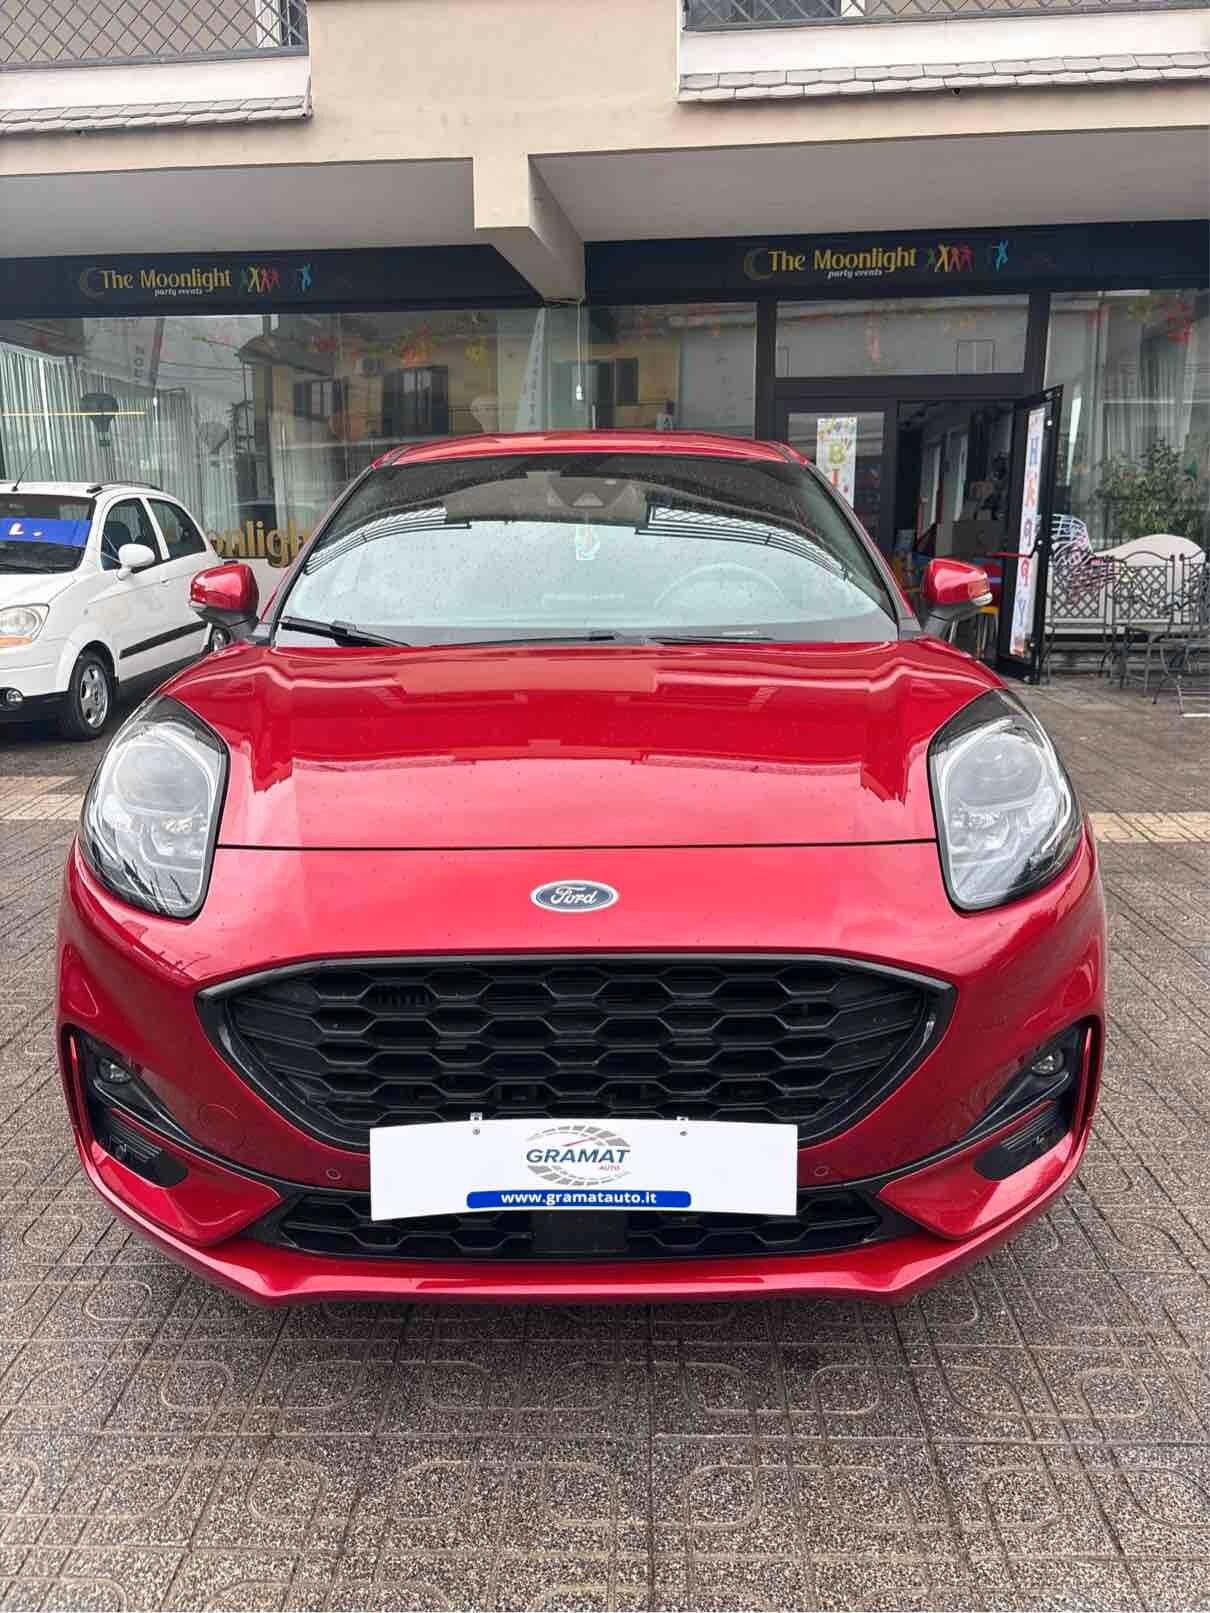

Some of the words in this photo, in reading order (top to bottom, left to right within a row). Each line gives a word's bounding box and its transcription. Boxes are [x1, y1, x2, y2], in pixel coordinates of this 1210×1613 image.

[768, 250, 806, 272] The
[813, 247, 917, 274] Moonlight
[100, 270, 133, 289] The
[140, 267, 232, 294] Moonlight
[827, 269, 852, 279] party
[854, 268, 883, 277] events
[154, 288, 177, 297] party
[178, 287, 203, 296] events
[550, 886, 599, 905] Ford
[526, 1149, 631, 1164] GRAMAT
[599, 1164, 621, 1172] AUTO
[501, 1190, 657, 1206] www.gramatauto.it
